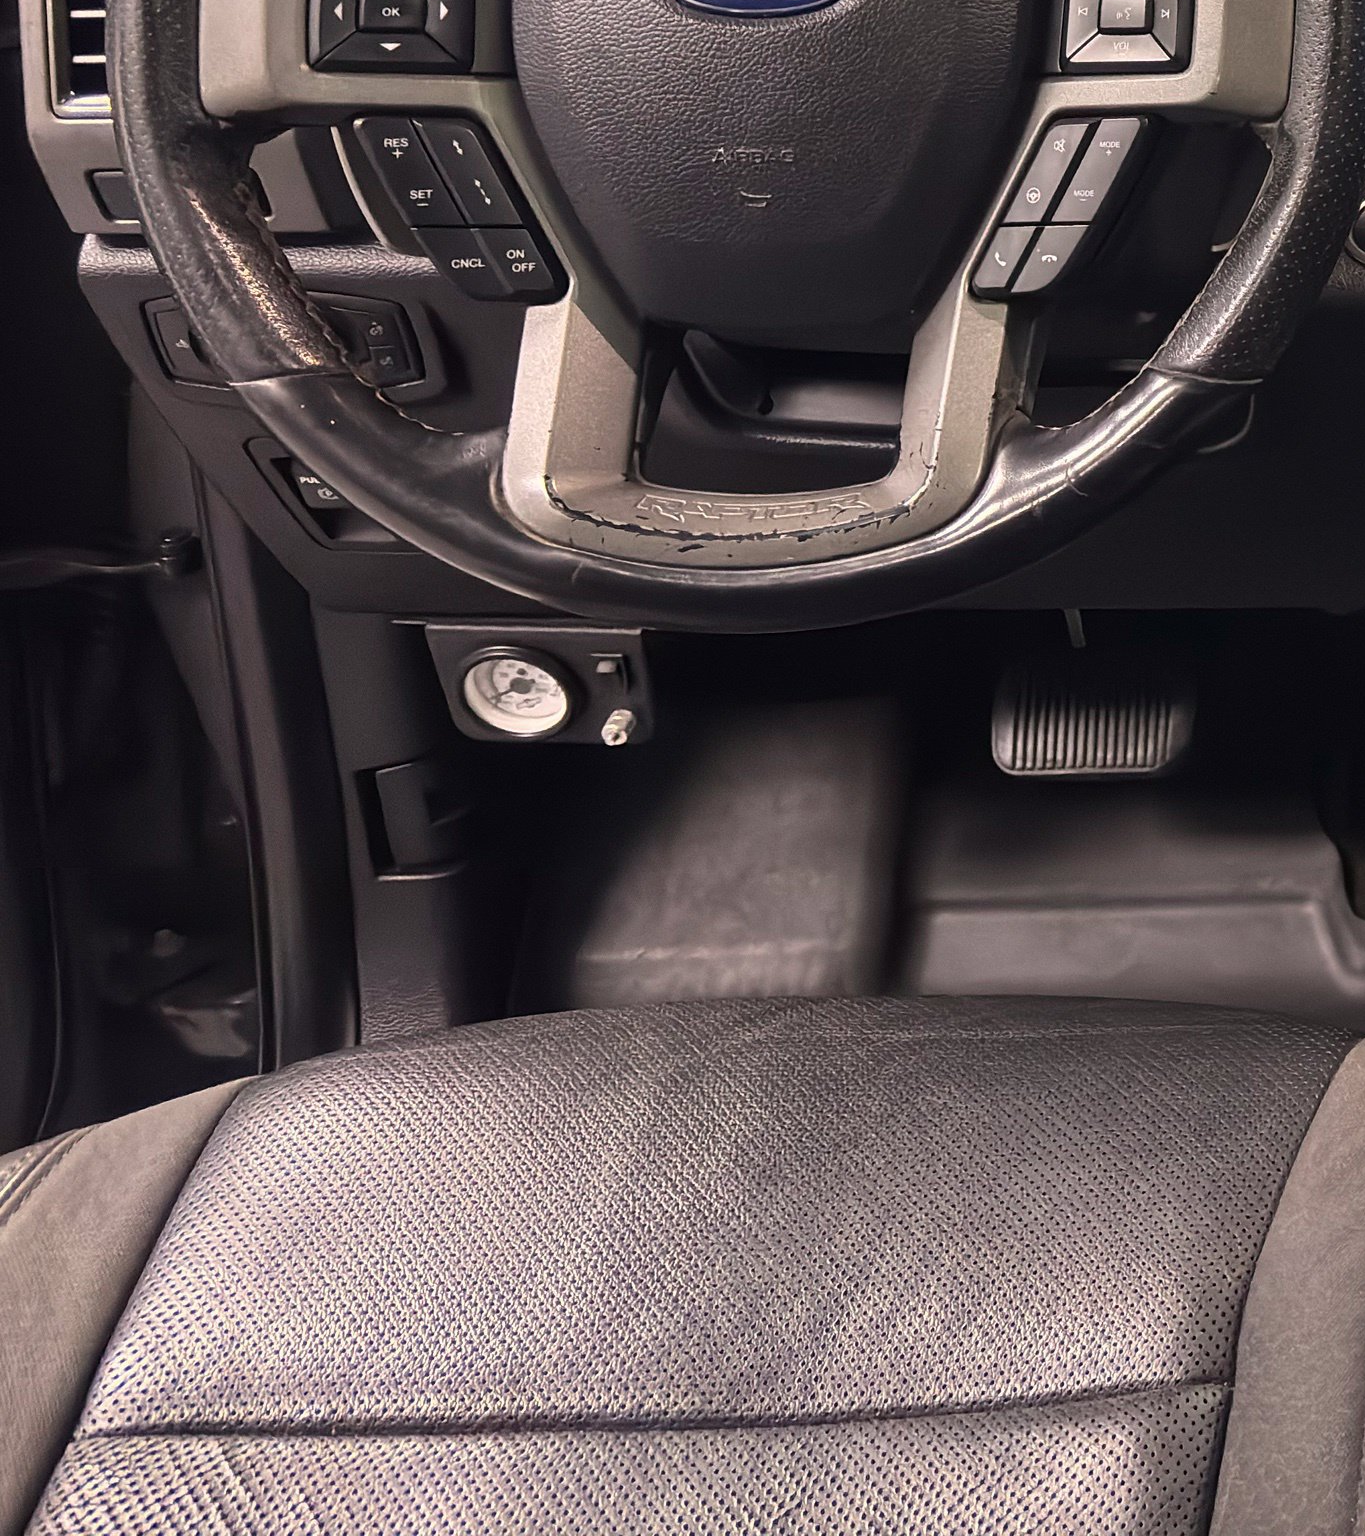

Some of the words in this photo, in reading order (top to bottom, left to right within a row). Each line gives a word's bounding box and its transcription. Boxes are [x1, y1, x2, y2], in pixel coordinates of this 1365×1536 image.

[381, 7, 401, 17] OK
[383, 137, 409, 148] RES
[1098, 140, 1121, 149] MODE
[409, 189, 434, 200] SET
[1073, 189, 1095, 198] MODE
[505, 249, 525, 260] ON
[451, 258, 486, 269] CNCL
[511, 262, 537, 273] OFF
